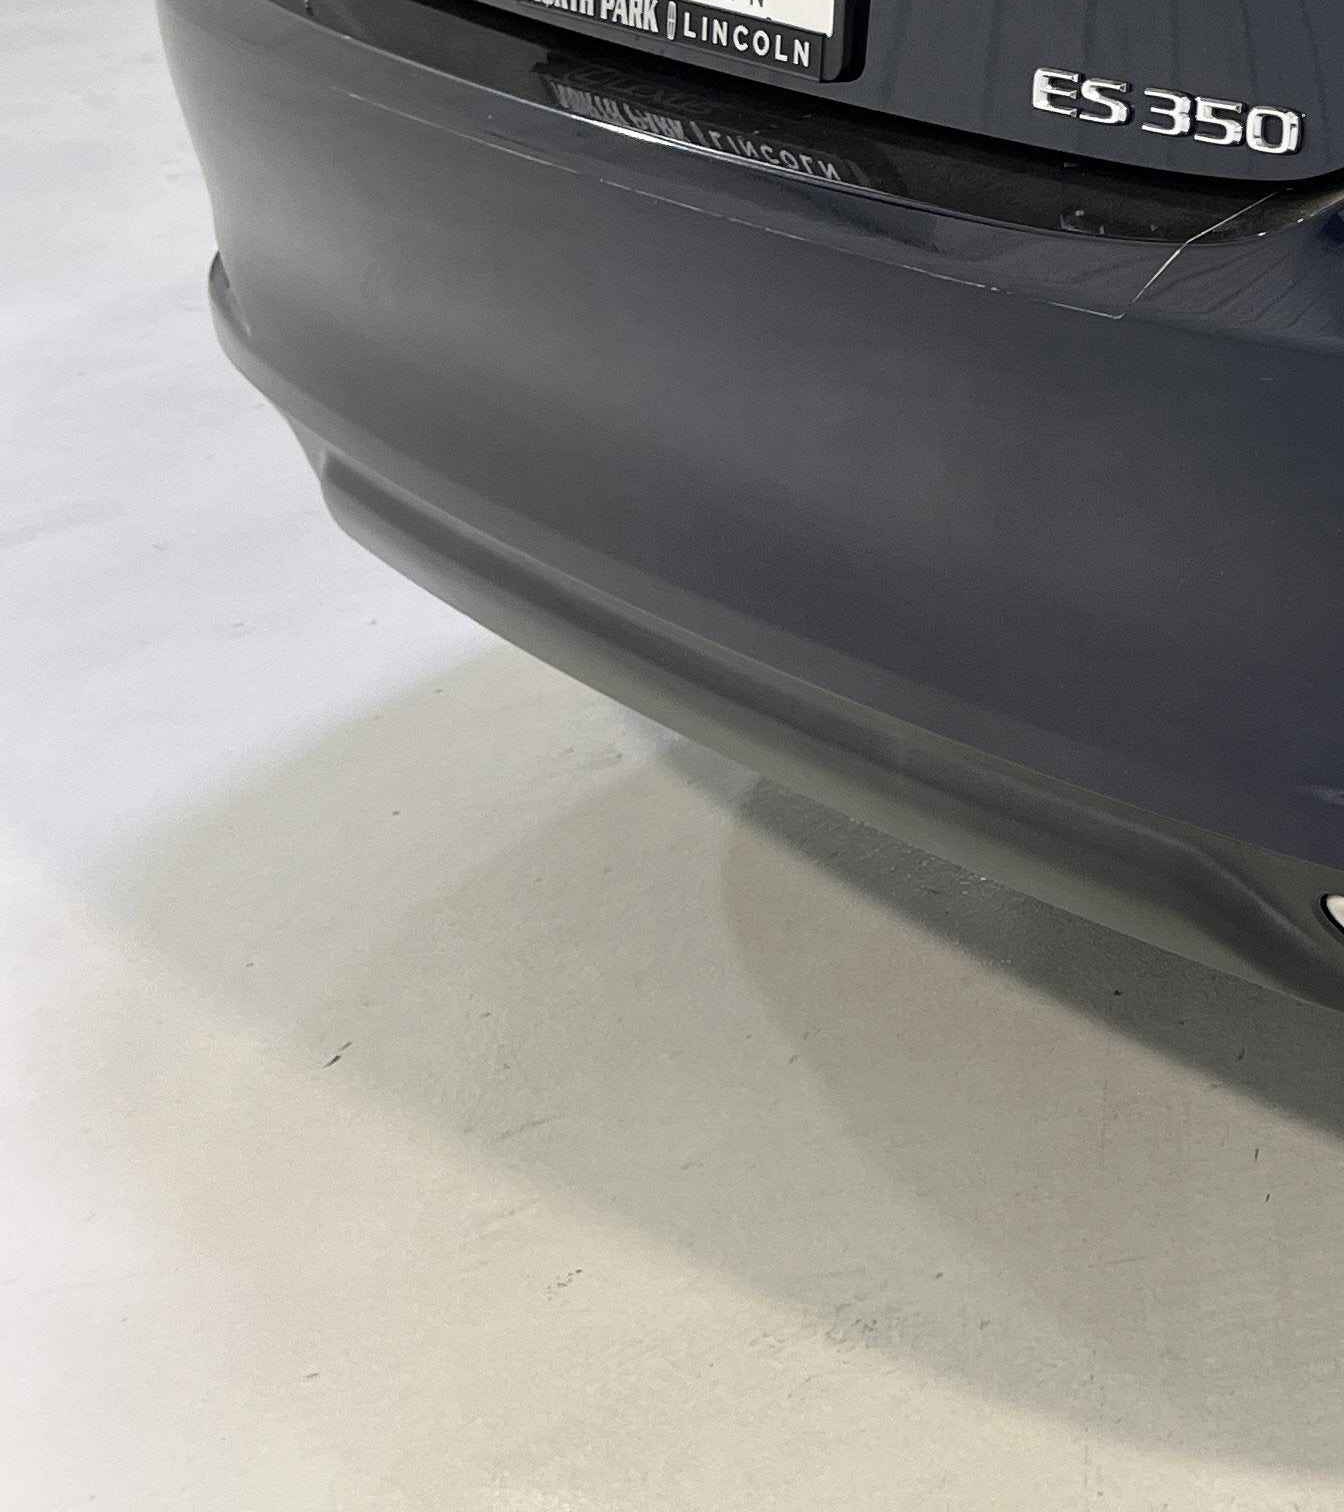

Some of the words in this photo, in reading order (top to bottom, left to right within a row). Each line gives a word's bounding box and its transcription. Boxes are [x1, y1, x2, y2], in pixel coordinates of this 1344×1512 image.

[683, 11, 811, 68] LINCOLN
[1031, 66, 1131, 126] ES
[1141, 87, 1302, 156] 350
